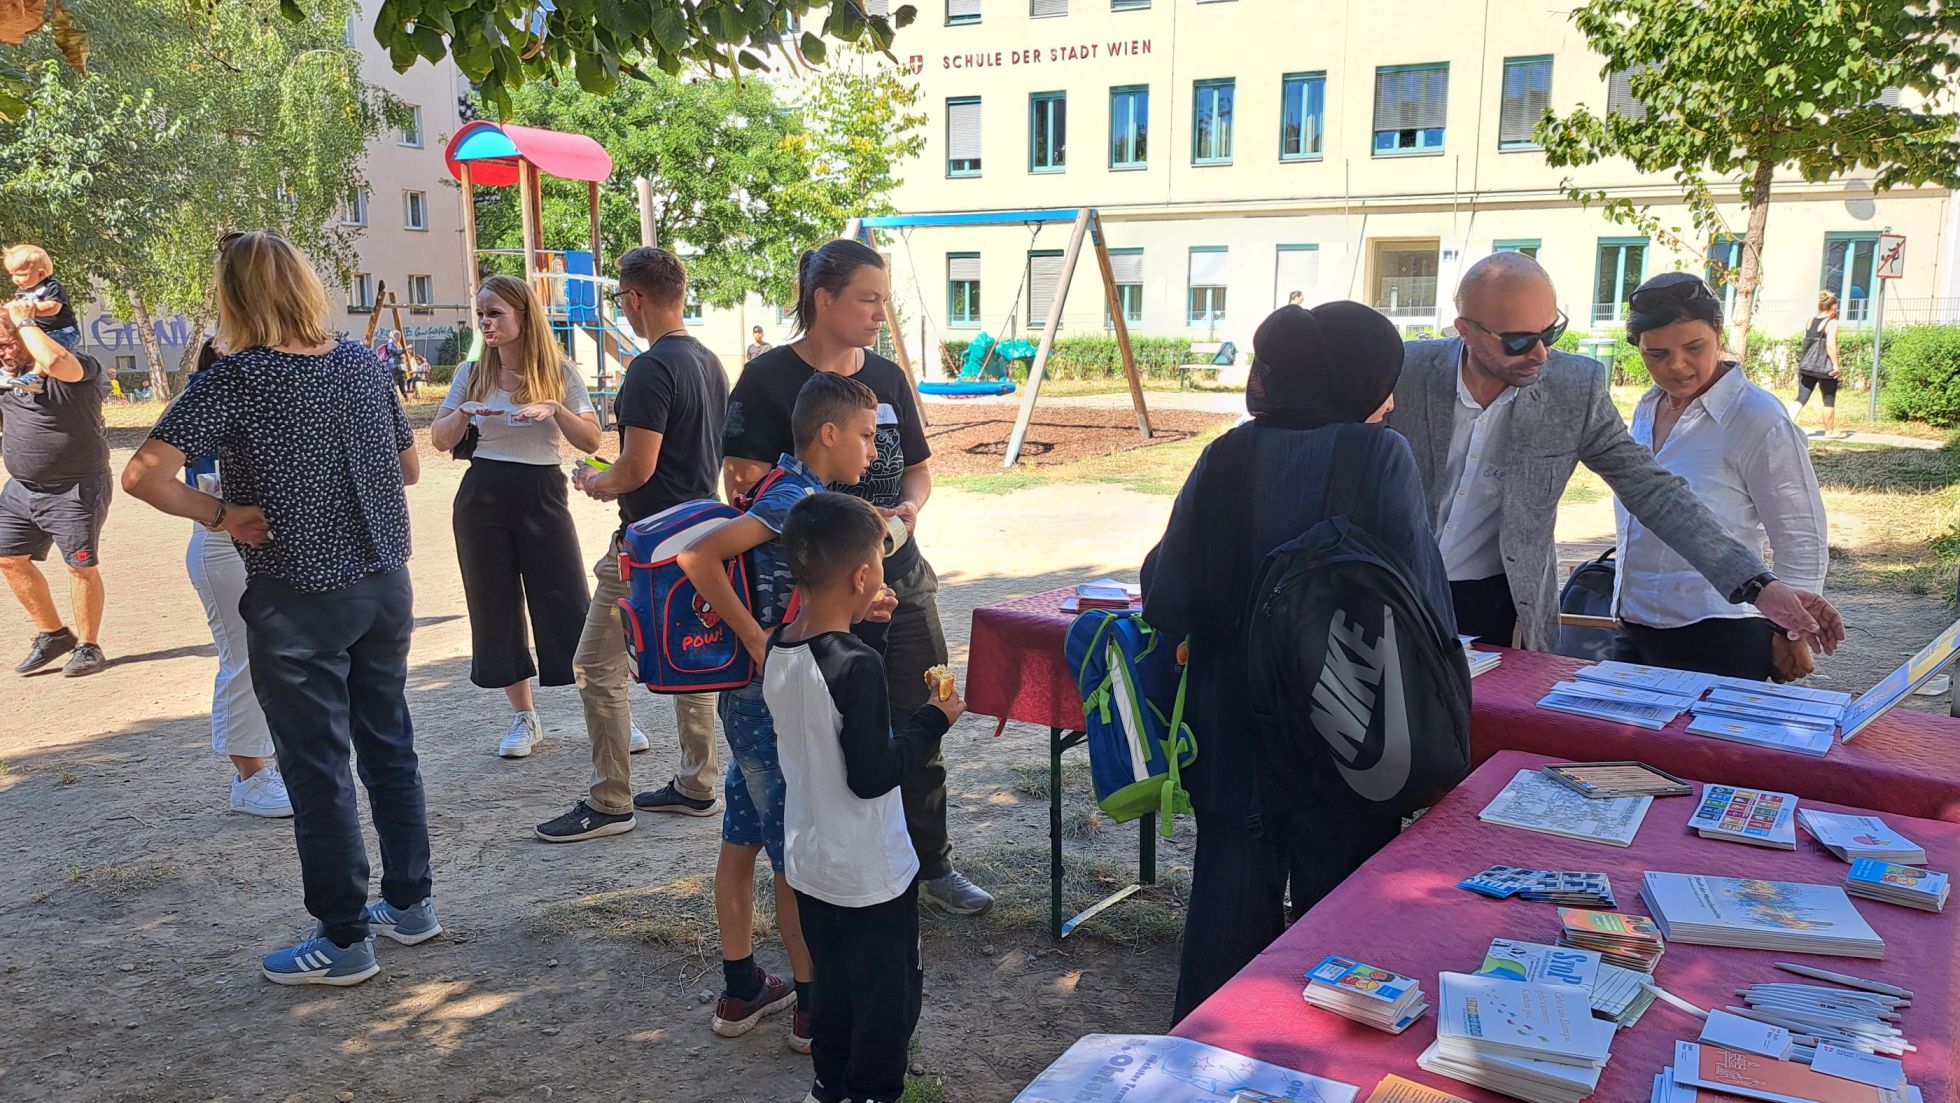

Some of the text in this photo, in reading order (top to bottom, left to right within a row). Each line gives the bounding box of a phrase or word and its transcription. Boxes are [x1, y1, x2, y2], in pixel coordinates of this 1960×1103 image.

[943, 39, 1151, 69] SCHULE DER STADT WIEN
[681, 627, 723, 651] POW!
[1310, 607, 1385, 764] NIKE
